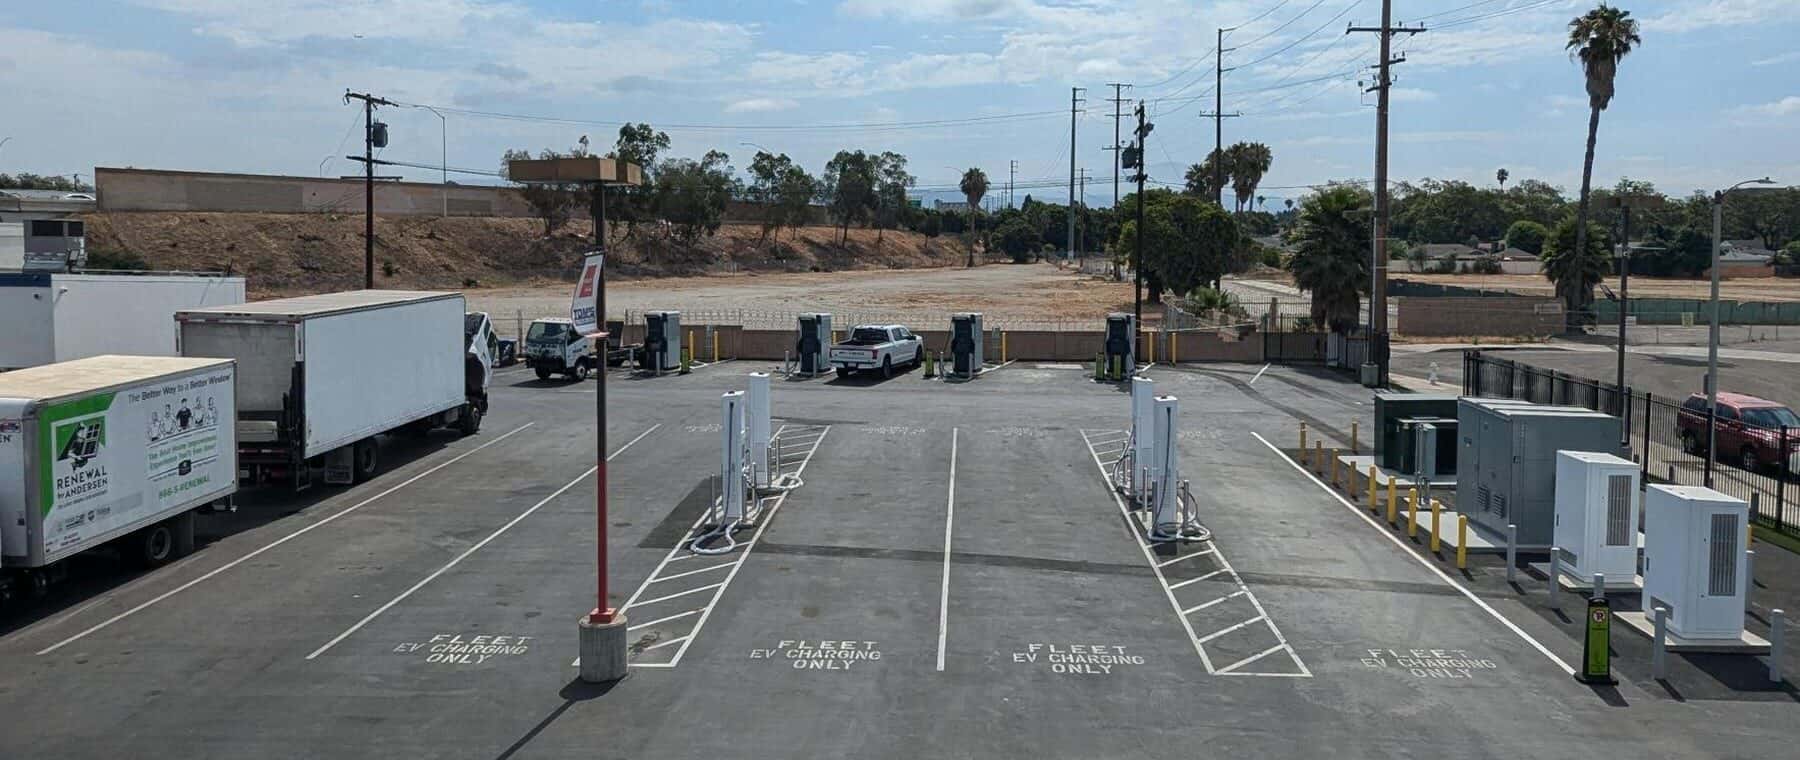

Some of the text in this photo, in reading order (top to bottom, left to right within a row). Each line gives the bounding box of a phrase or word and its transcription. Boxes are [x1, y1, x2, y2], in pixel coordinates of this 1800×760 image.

[128, 393, 140, 404] The
[142, 390, 161, 401] Better
[162, 385, 176, 396] Way
[57, 466, 107, 489] RENEWAL
[65, 478, 108, 498] ANDERSEN
[429, 634, 535, 646] FLEET
[778, 640, 879, 650] FLEET
[393, 642, 528, 655] EV CHARGING
[1028, 643, 1127, 655] FLEET
[1367, 649, 1467, 658] FLEET
[426, 653, 492, 664] ONLY
[750, 649, 881, 660] EV CHARGING
[1013, 652, 1145, 665] EV CHARGING
[792, 659, 855, 670] ONLY
[1052, 663, 1112, 674] ONLY
[1361, 658, 1497, 668] EV CHARGING
[1410, 668, 1473, 679] ONLY
